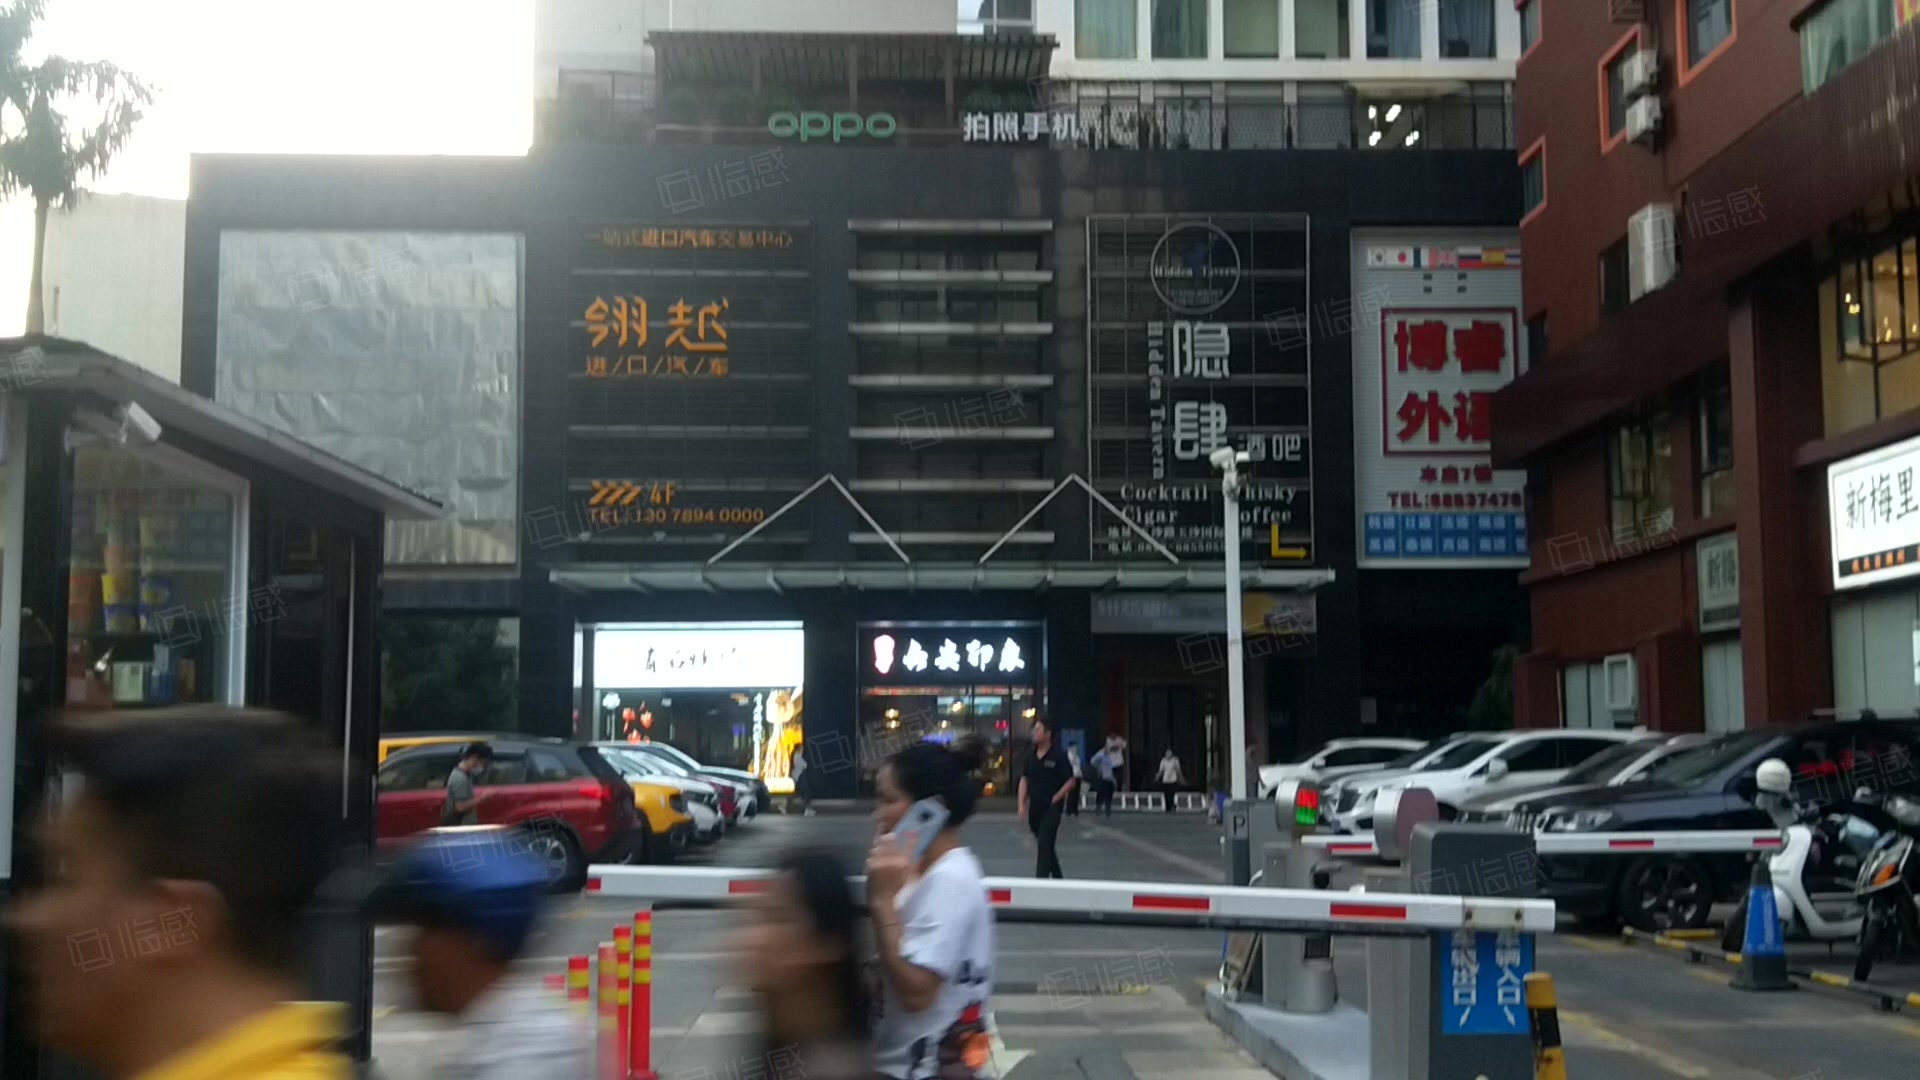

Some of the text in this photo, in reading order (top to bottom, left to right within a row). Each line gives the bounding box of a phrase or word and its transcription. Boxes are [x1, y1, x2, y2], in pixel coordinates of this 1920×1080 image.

[963, 112, 1081, 143] 拍照手机
[1846, 466, 1919, 530] 新梅里
[719, 507, 764, 524] 0000
